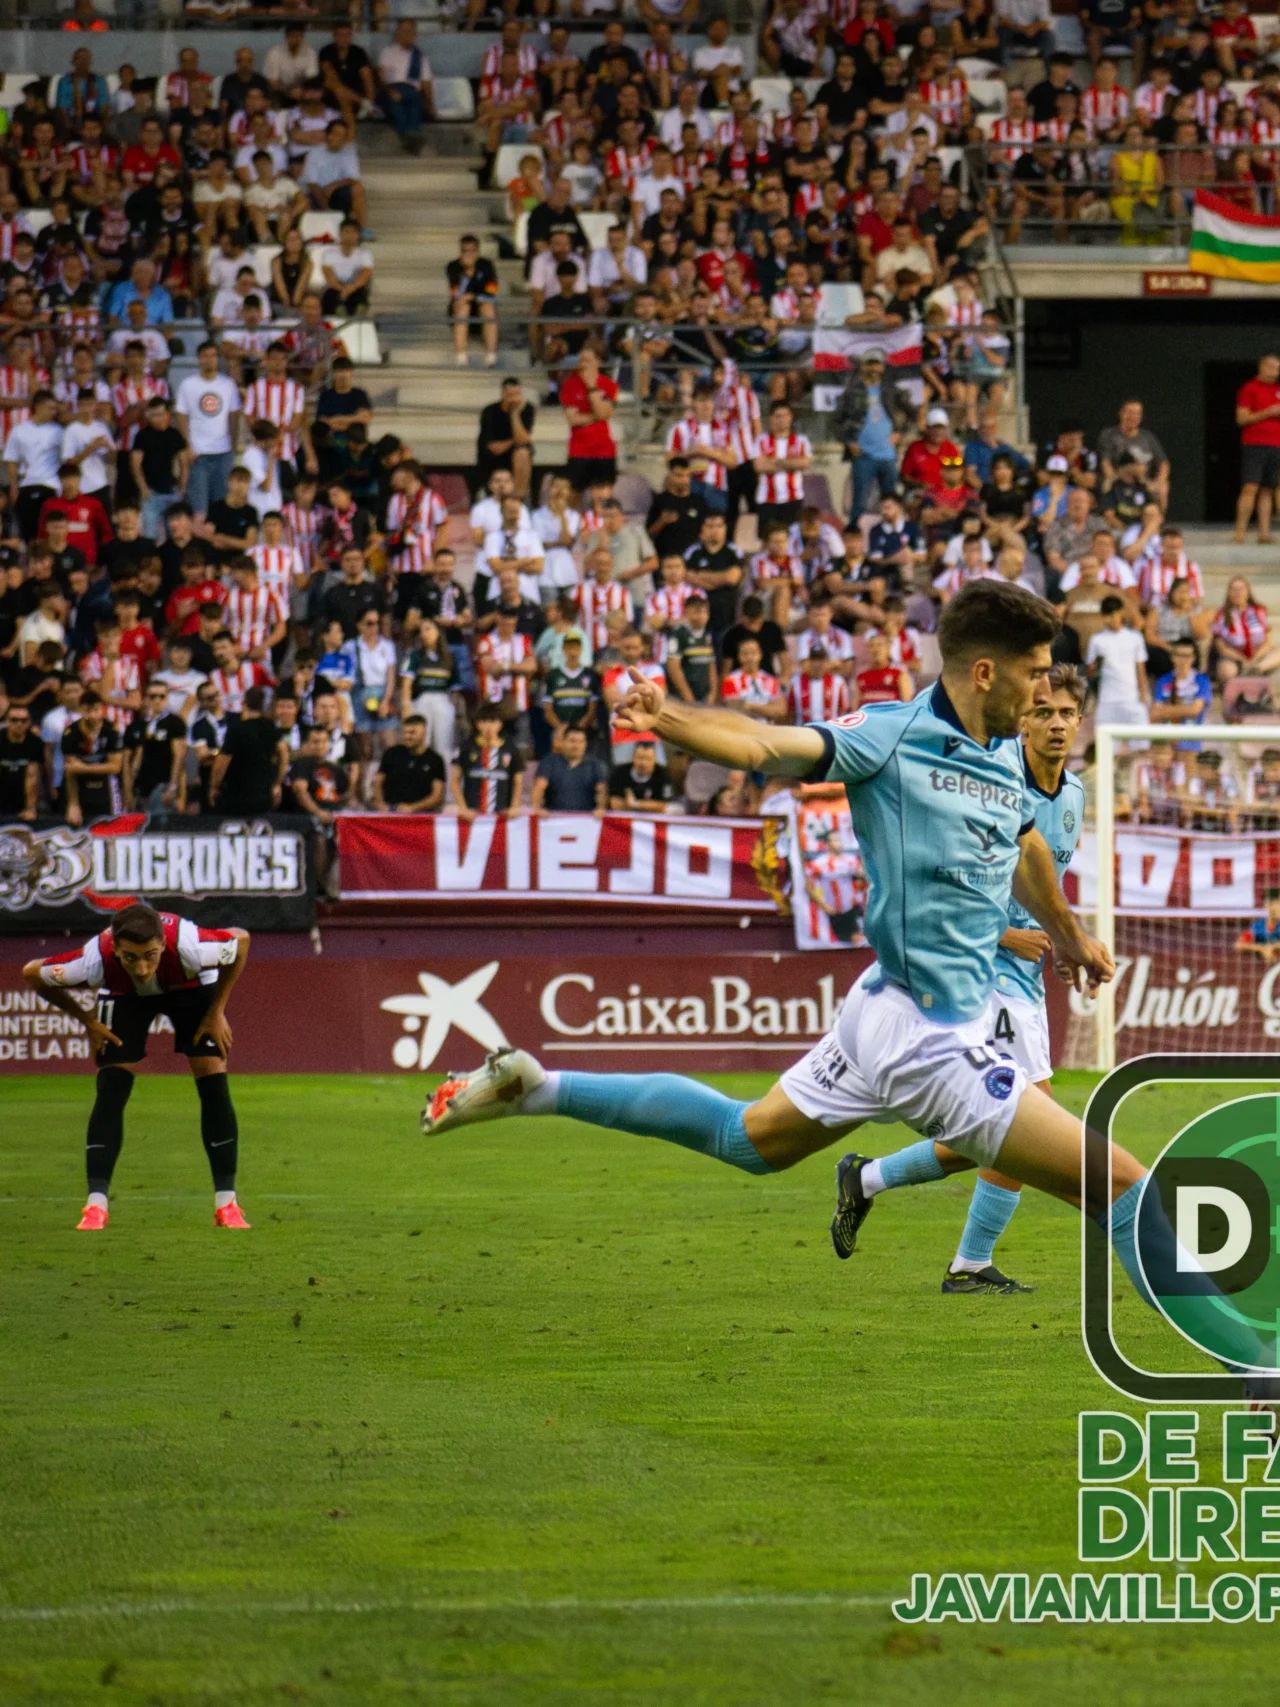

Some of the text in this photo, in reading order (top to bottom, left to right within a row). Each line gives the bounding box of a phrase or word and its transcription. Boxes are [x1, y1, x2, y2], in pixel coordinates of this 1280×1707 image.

[928, 769, 1022, 814] telepizz
[92, 822, 299, 893] LOGROÑÉS
[541, 973, 845, 1036] CaixaBank
[0, 1038, 29, 1060] DE
[32, 1038, 63, 1060] LA
